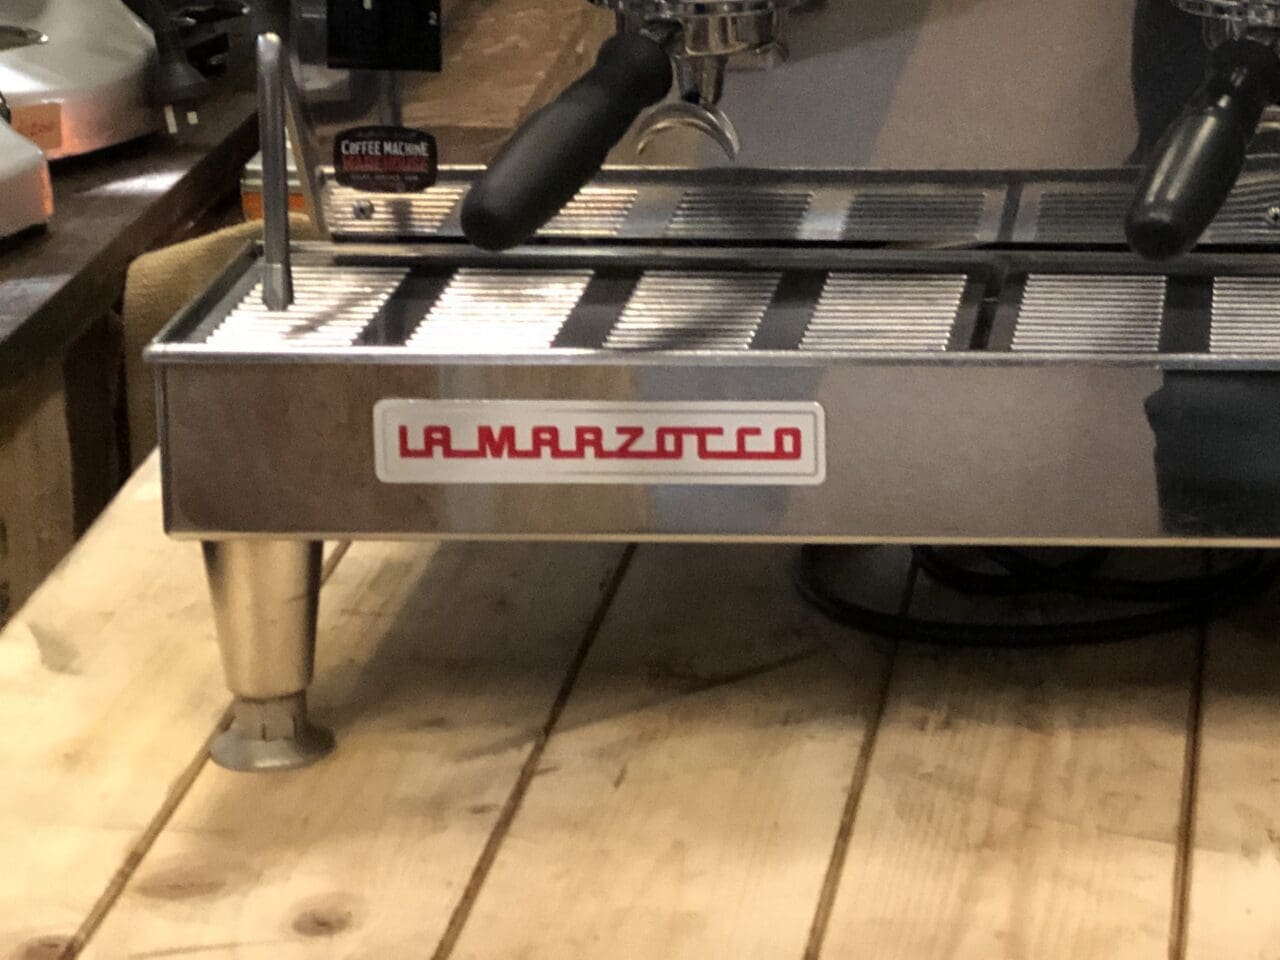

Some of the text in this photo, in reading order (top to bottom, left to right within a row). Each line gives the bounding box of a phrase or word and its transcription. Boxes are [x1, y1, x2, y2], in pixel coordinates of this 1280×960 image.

[341, 139, 429, 156] COFFEE MACHINE
[399, 425, 802, 460] LA MARZOCCO
